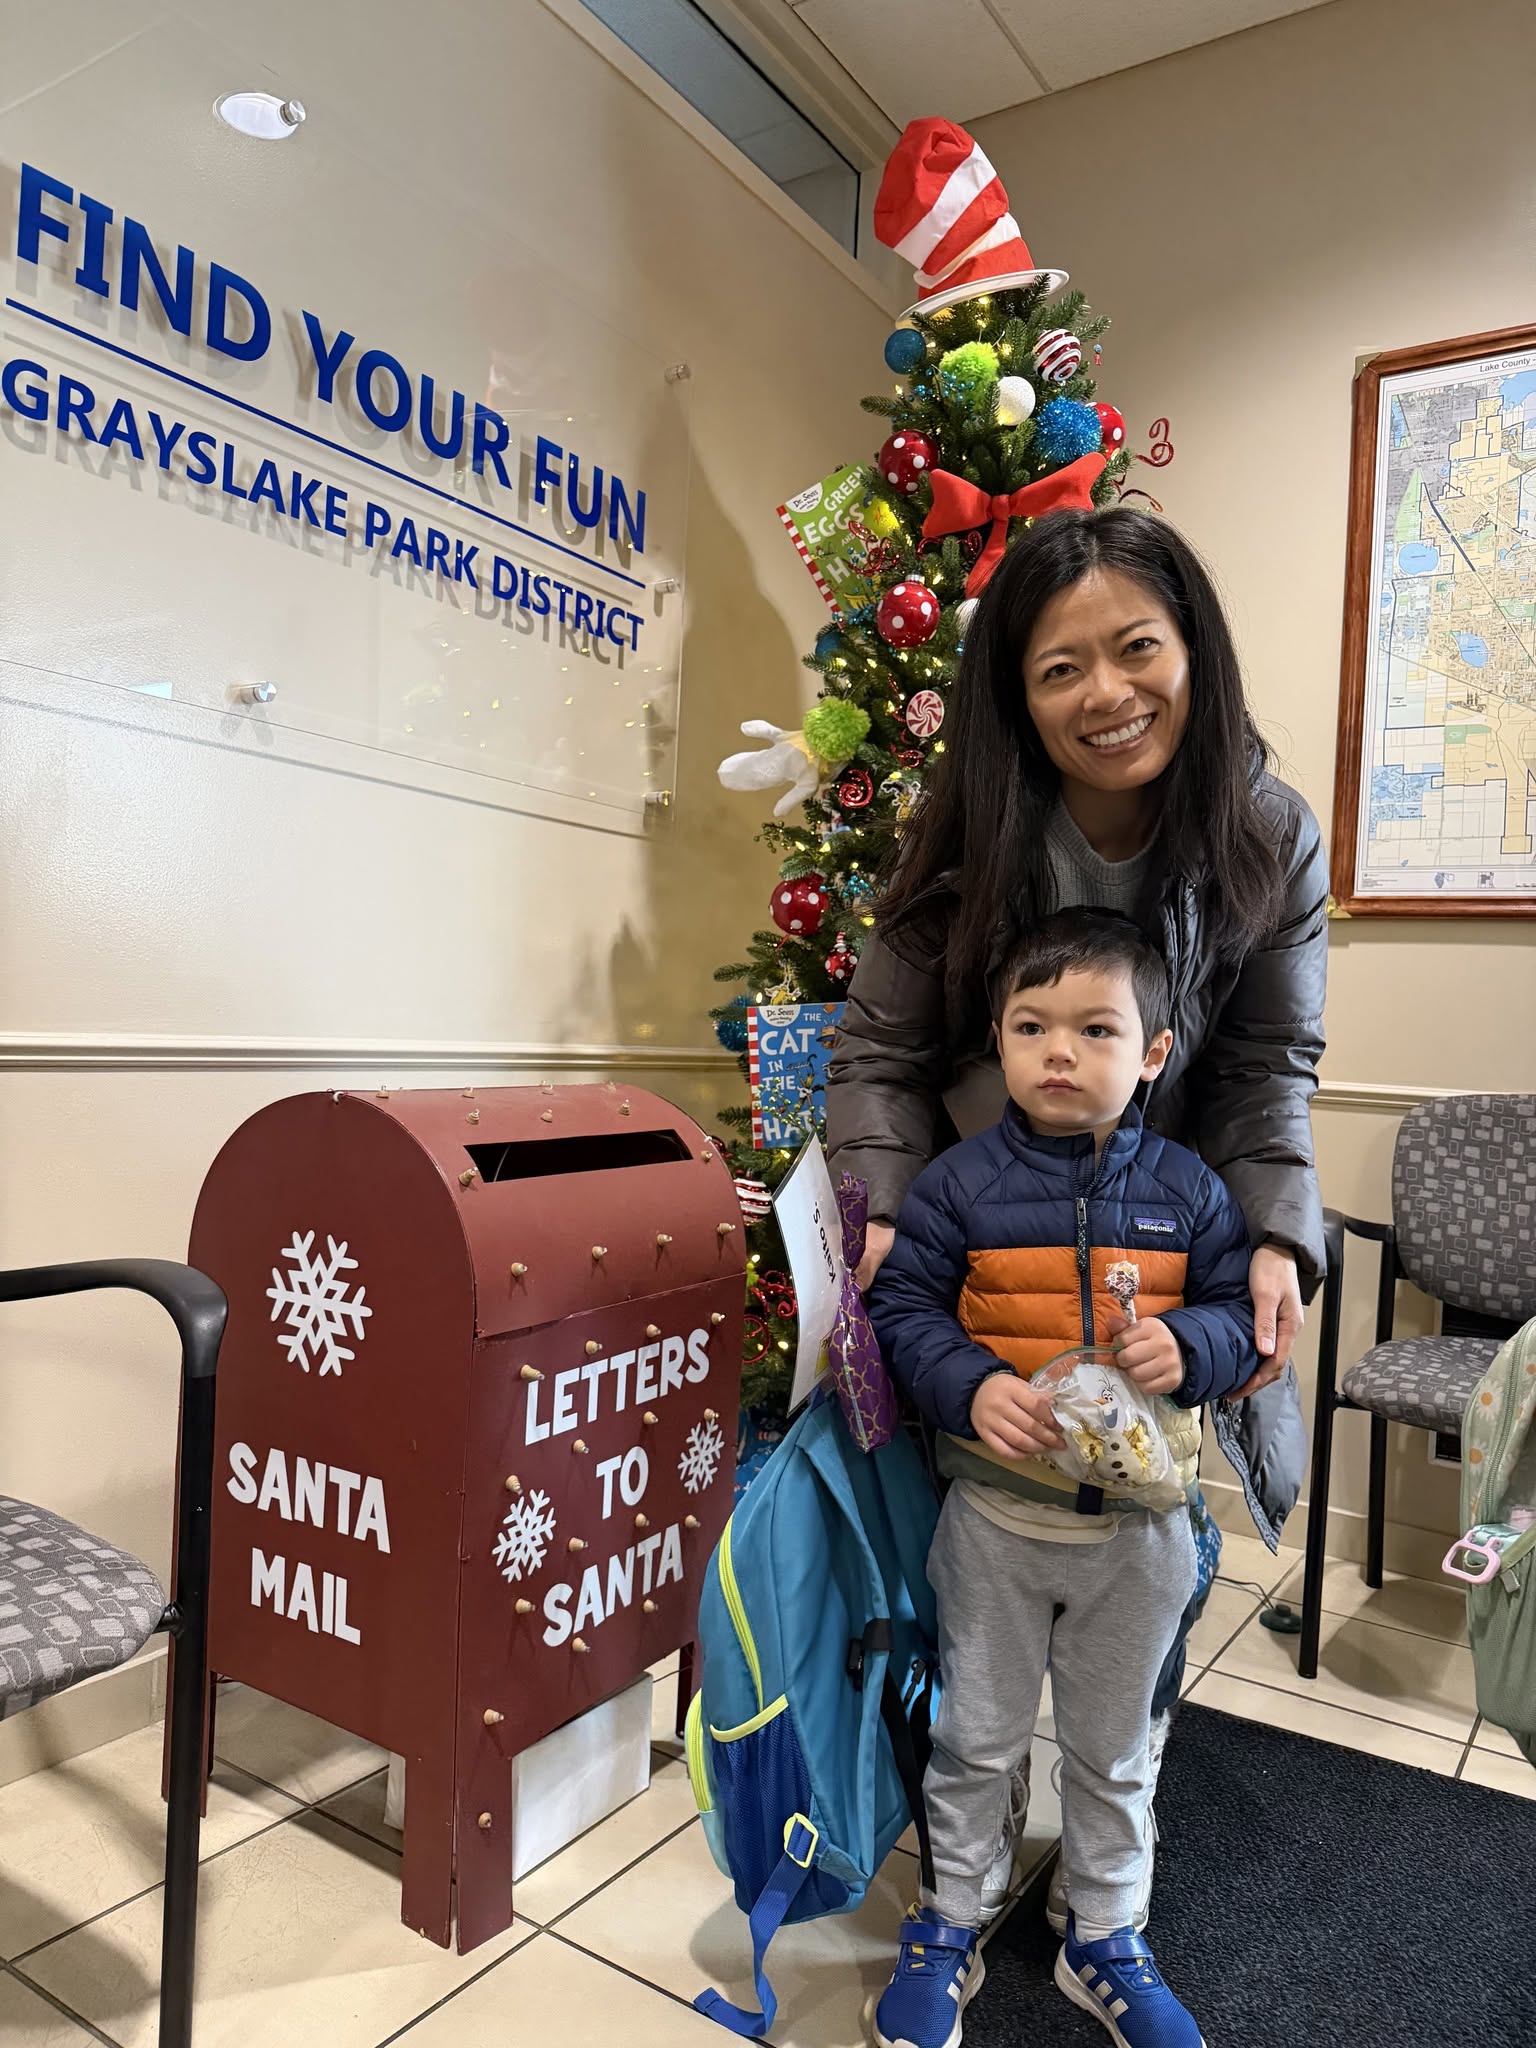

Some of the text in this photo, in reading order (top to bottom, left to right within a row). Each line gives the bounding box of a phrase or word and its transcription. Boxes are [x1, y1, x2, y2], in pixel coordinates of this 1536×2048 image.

[17, 162, 646, 553] FIND YOUR FUN
[1480, 357, 1531, 372] Lake County
[2, 359, 644, 651] GRAYSLAKE PARK DISTRICT
[803, 503, 864, 544] EGGS
[761, 1028, 816, 1056] CAT
[803, 1012, 821, 1022] THE
[762, 1075, 796, 1091] THE
[768, 1059, 783, 1073] IN
[819, 1227, 836, 1283] Kaito
[1138, 1224, 1174, 1233] patagonia
[524, 1328, 710, 1446] LETTERS
[226, 1442, 391, 1554] SANTA
[596, 1446, 649, 1520] TO
[251, 1548, 361, 1646] MAIL
[542, 1523, 684, 1647] SANTA
